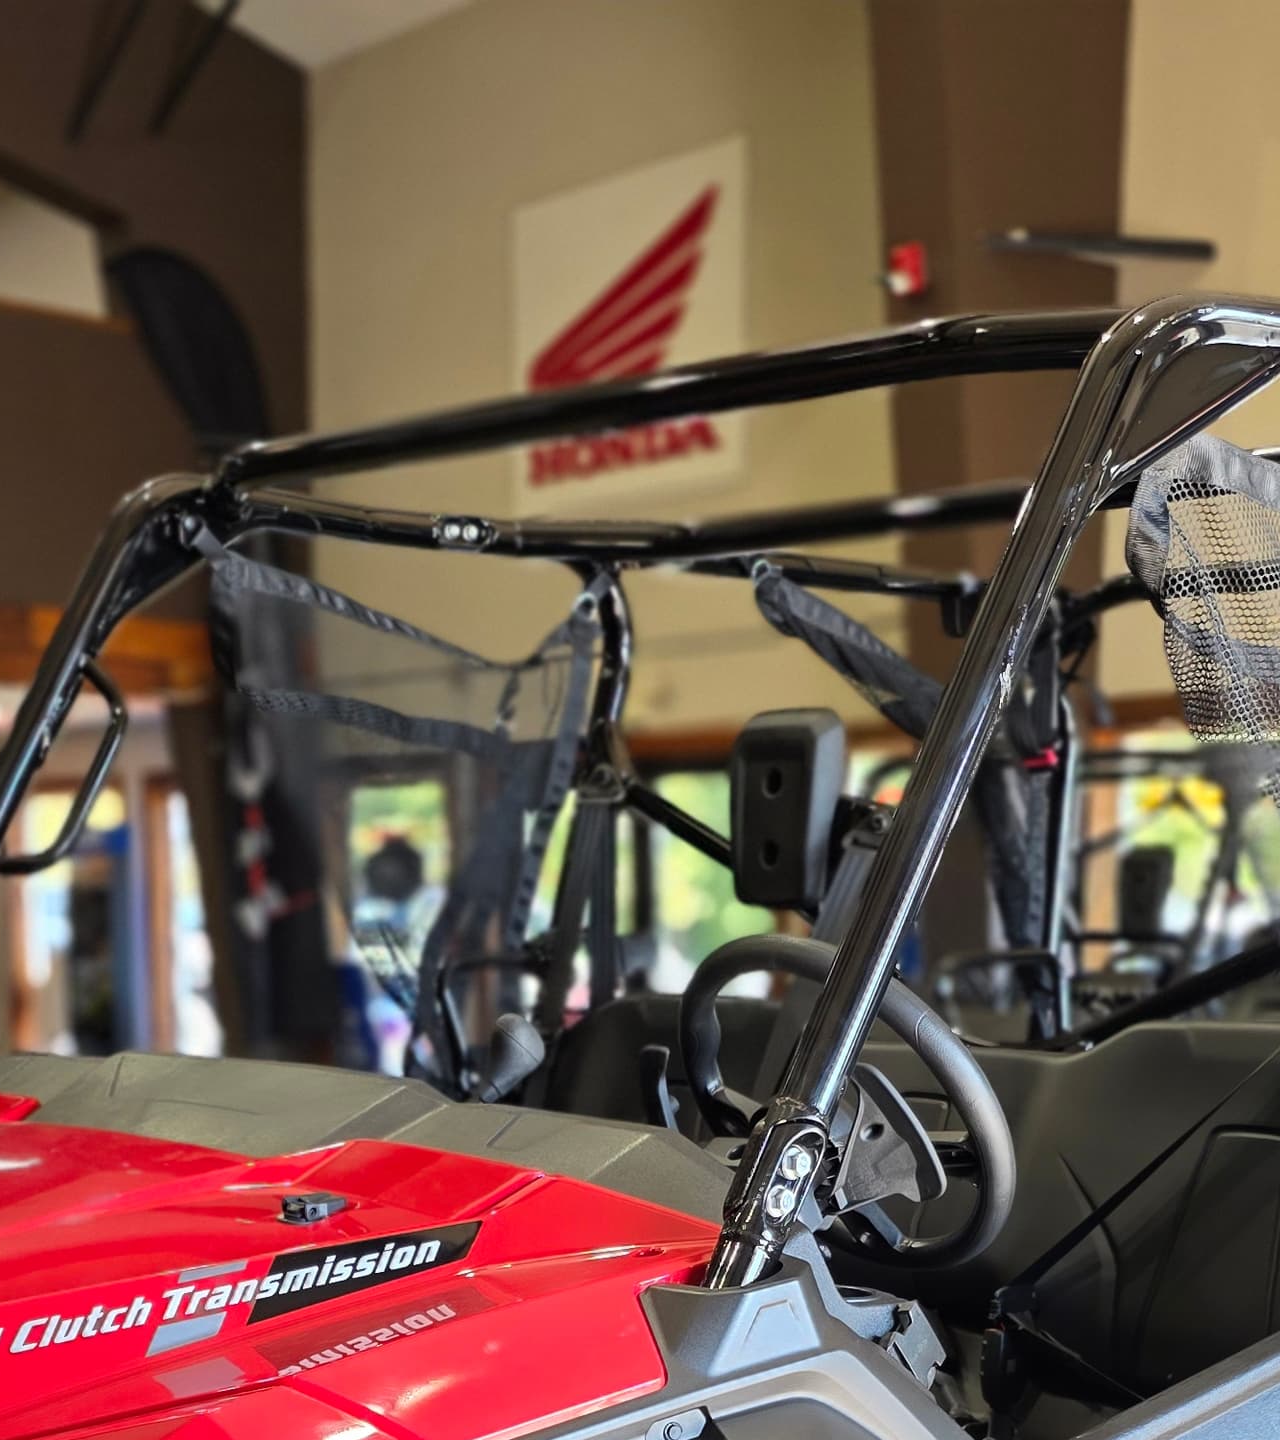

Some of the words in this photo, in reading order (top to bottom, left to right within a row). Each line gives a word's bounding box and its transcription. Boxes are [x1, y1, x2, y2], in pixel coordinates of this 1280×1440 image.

[528, 413, 721, 487] HONDA
[9, 1296, 152, 1354] Clutch
[162, 1239, 441, 1320] Transmission
